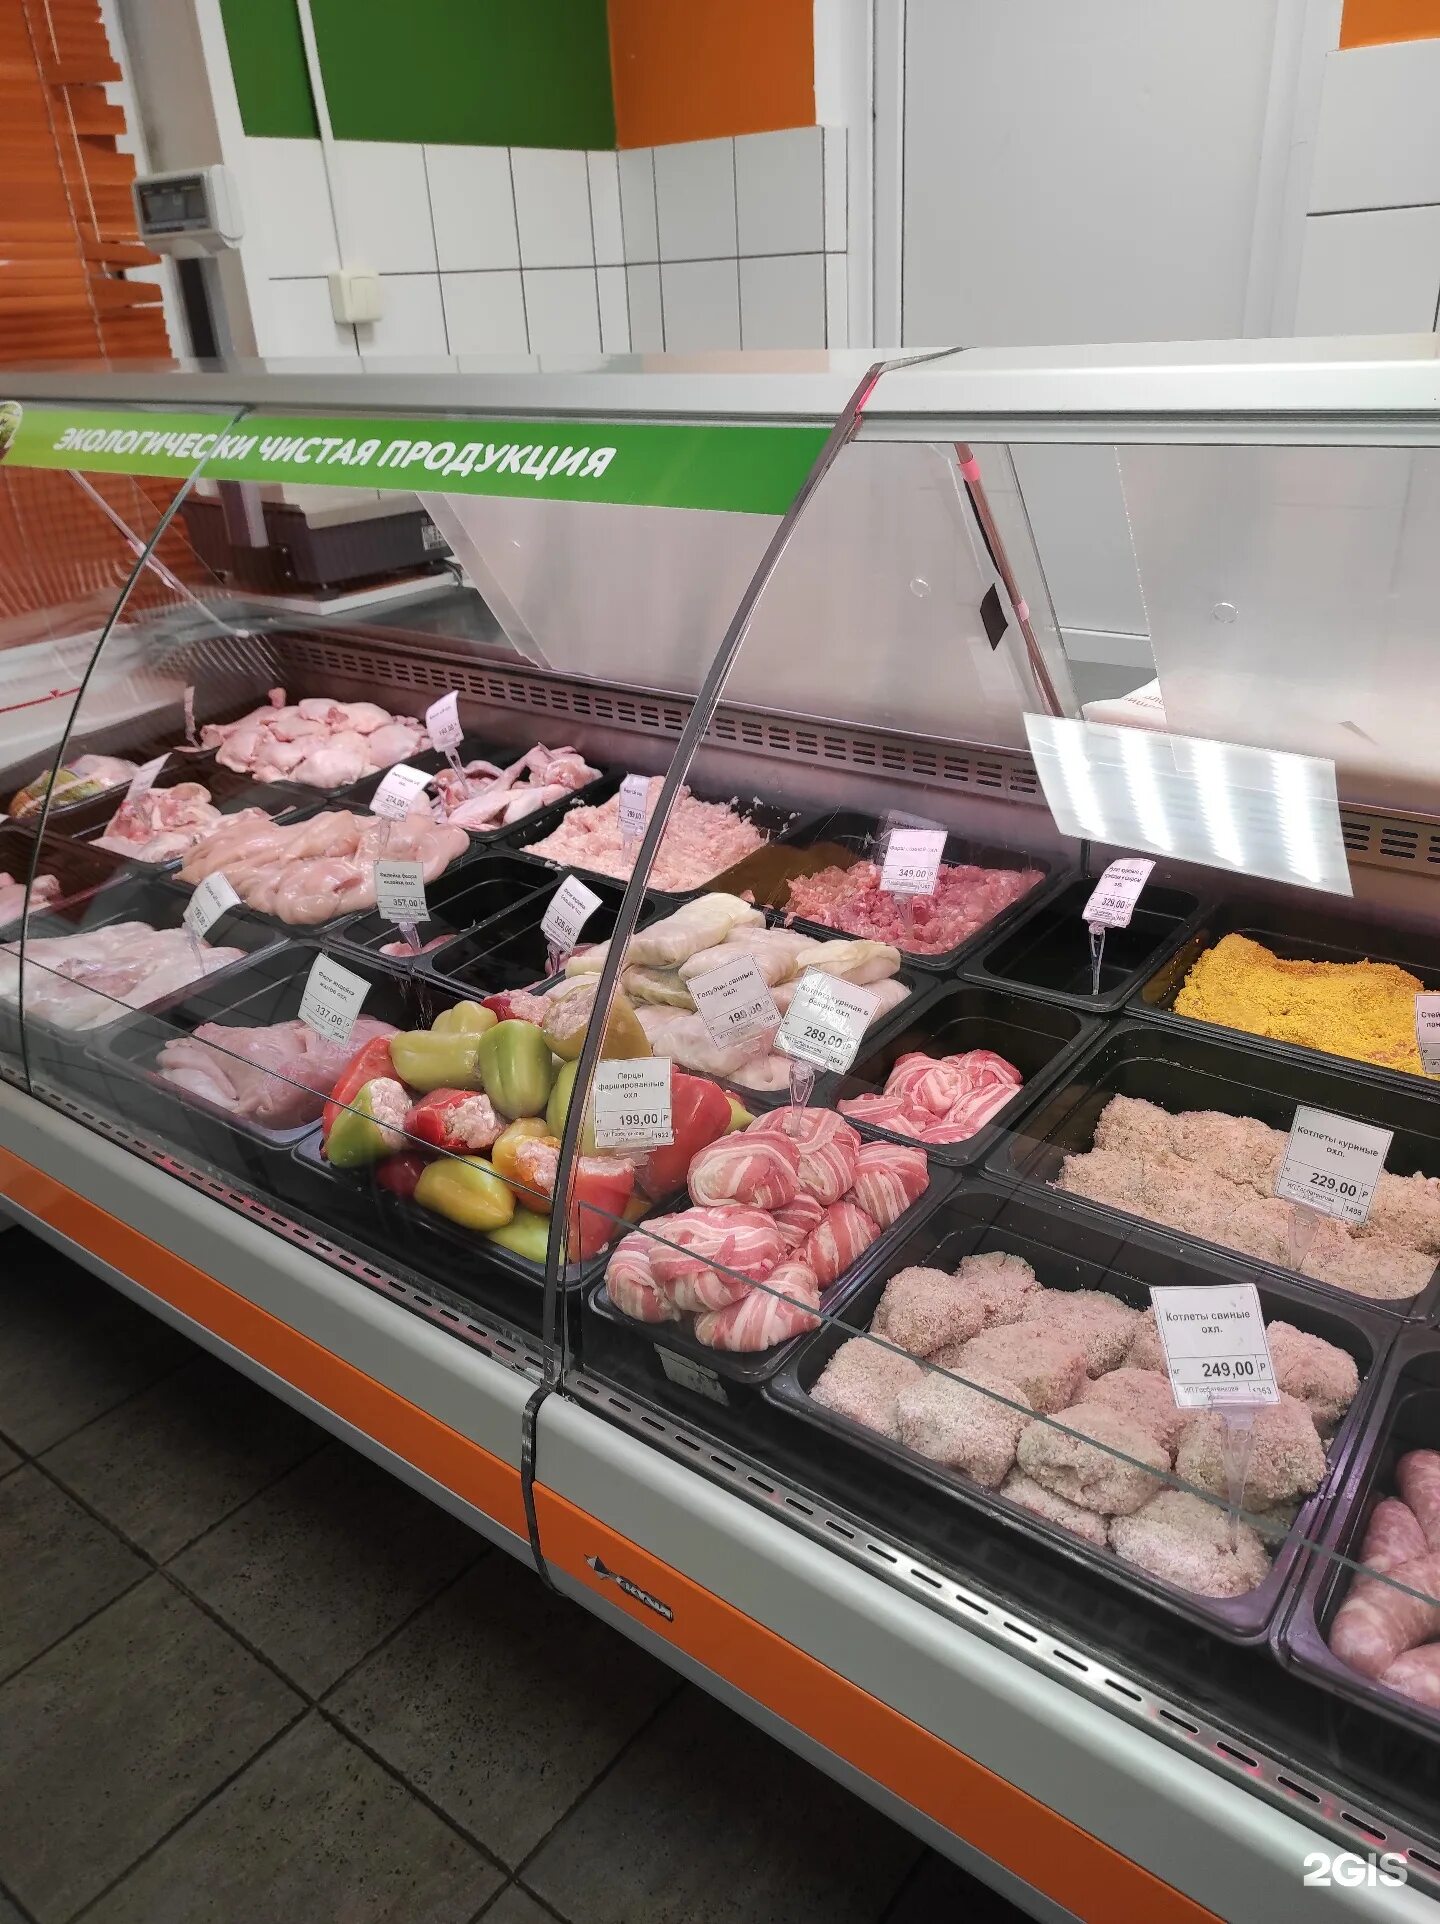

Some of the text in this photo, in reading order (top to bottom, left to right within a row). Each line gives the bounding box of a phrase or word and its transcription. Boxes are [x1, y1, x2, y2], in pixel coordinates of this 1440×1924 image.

[53, 428, 617, 481] ЭКОЛОГИЧЕСКИ ЧИСТАЯ ПРОДУКЦИЯ
[898, 868, 926, 878] 349,00
[1102, 897, 1126, 909] 329,00
[696, 970, 754, 1000] Голубцы свиные
[832, 996, 862, 1013] куриная
[316, 1004, 342, 1026] 337,00
[804, 1026, 843, 1048] 289,00
[618, 1072, 644, 1080] Перцы
[598, 1081, 664, 1092] фаршированные
[620, 1113, 658, 1126] 199,00
[1297, 1126, 1379, 1157] Котлеты куриные
[1326, 1146, 1345, 1158] охл.
[1310, 1172, 1357, 1197] 229,00
[1166, 1311, 1251, 1322] Котлеты свиные
[1201, 1326, 1223, 1334] охл.
[1202, 1360, 1254, 1378] 249,00
